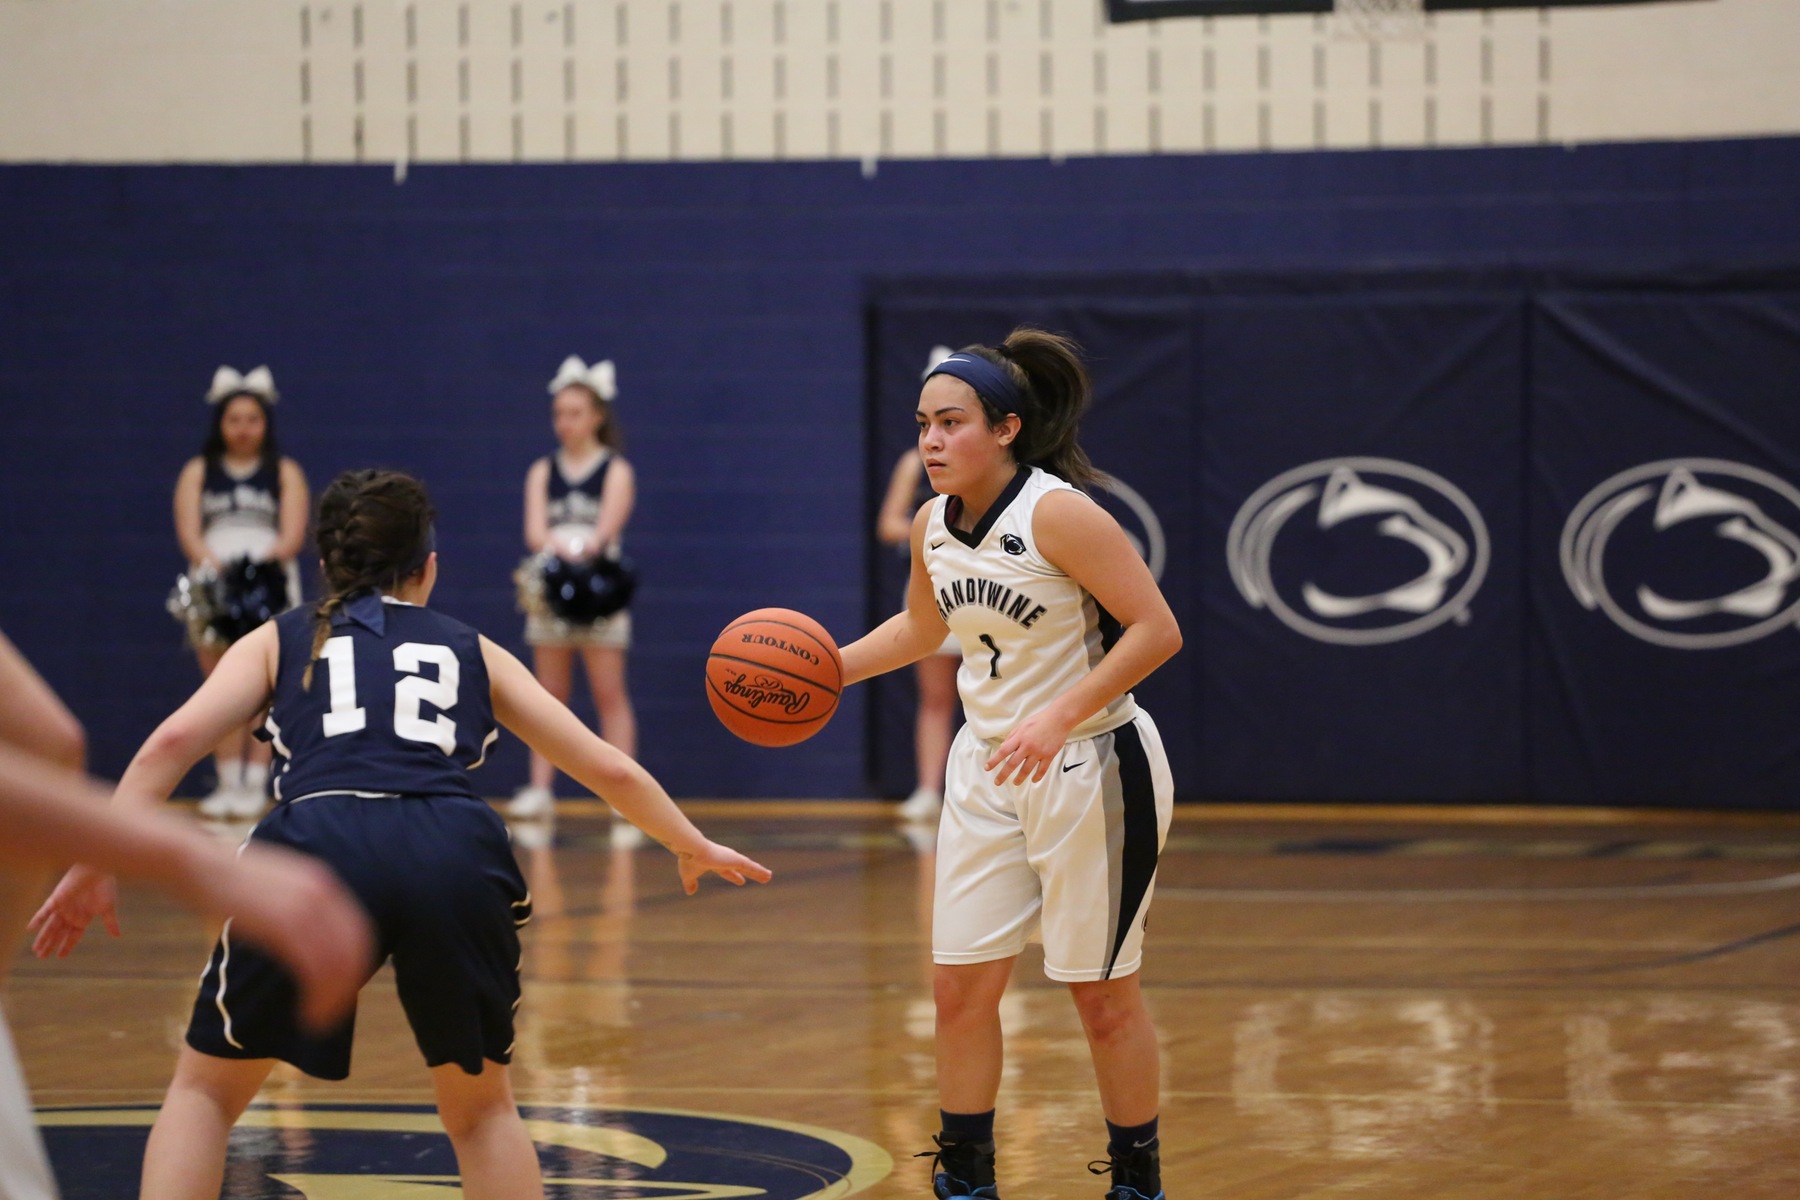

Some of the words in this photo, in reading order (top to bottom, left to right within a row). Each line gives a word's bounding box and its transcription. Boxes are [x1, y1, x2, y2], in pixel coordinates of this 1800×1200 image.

[742, 634, 820, 666] CONTOUR
[979, 634, 1002, 680] 1
[319, 636, 460, 757] 12
[724, 673, 810, 715] Rawlings
